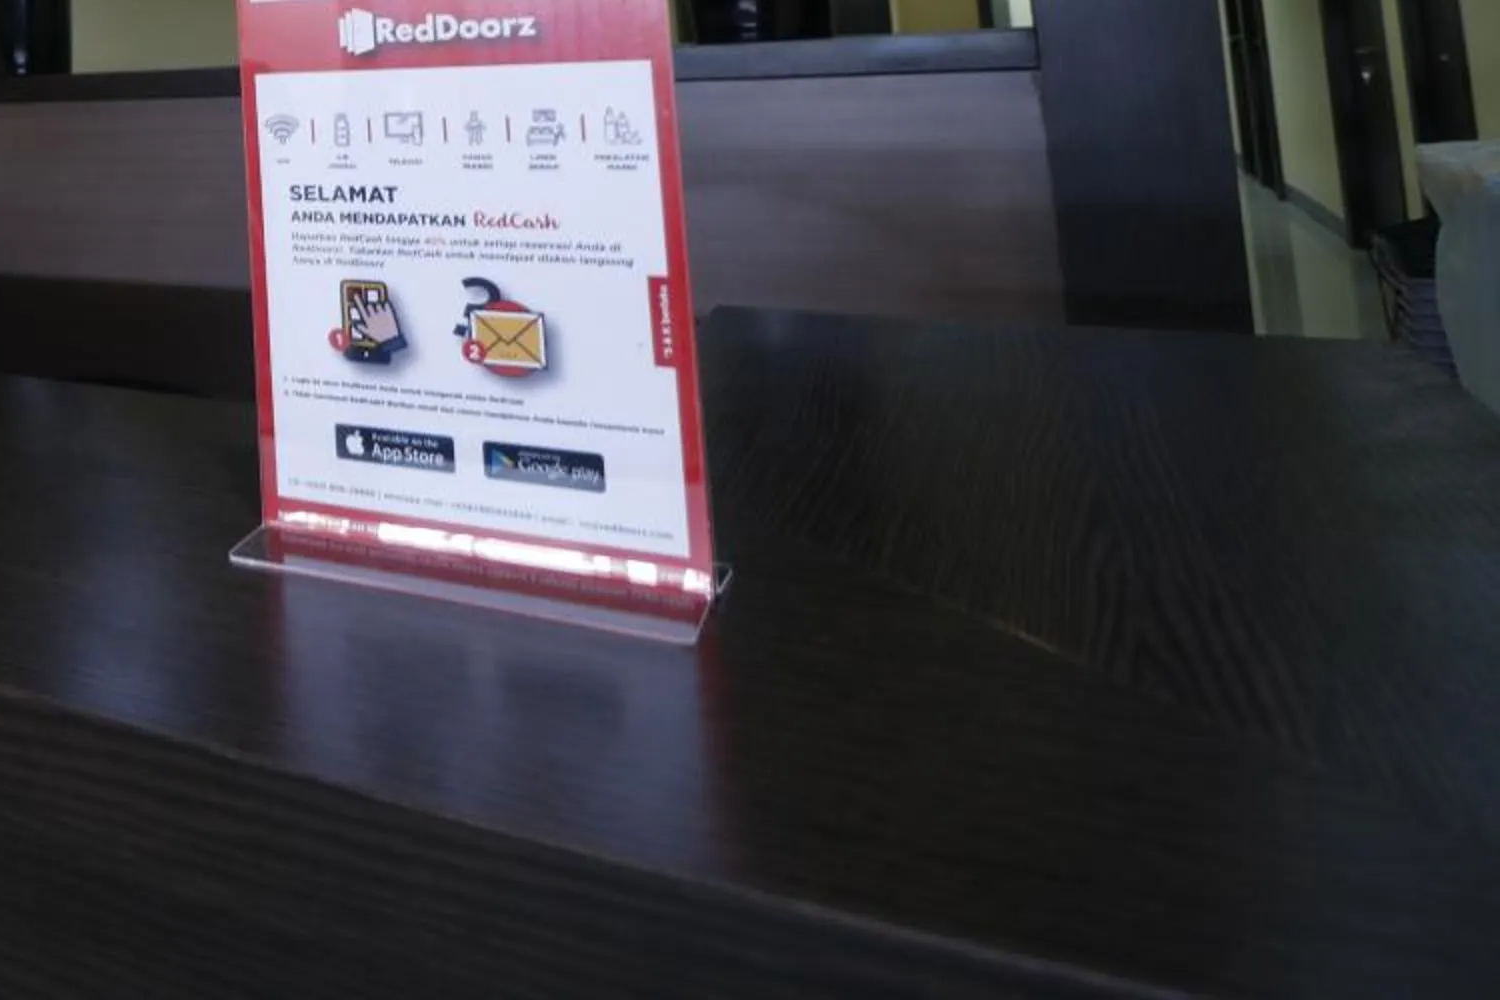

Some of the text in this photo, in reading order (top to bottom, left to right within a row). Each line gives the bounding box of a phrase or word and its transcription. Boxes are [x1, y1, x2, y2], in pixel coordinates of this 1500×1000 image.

[375, 12, 536, 44] RedDoorz
[290, 185, 398, 203] SELAMAT
[291, 210, 560, 229] ANDA MENDAPATKAN RedCash
[336, 333, 343, 346] 1
[469, 345, 481, 359] 2
[371, 444, 445, 467] App Store
[571, 465, 600, 485] play
